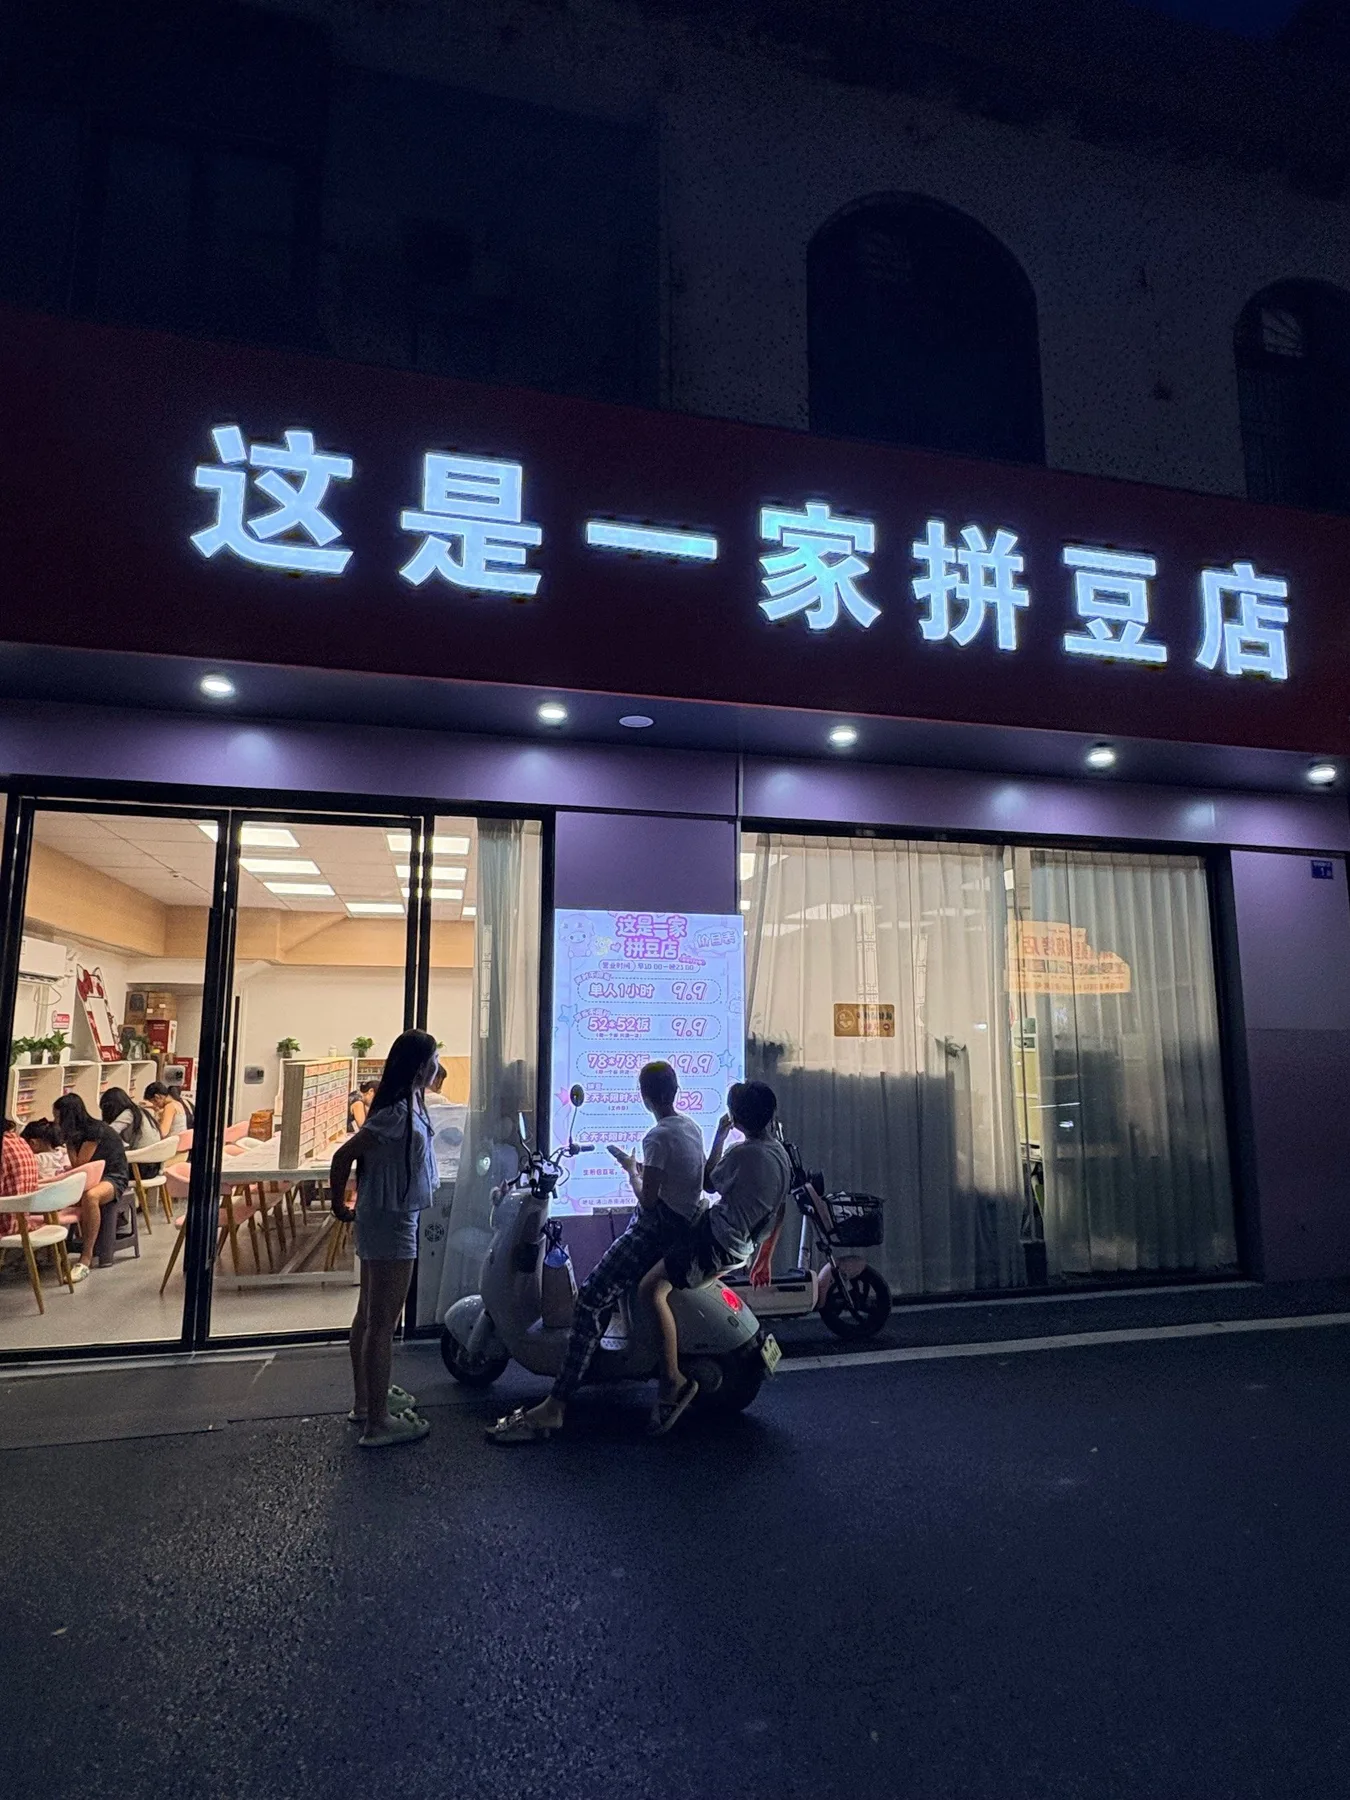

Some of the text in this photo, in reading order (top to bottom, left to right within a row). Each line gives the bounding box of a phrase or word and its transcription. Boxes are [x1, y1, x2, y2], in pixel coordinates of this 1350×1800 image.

[190, 424, 1291, 681] 这是一家拼豆店
[615, 914, 688, 939] 这是一家
[624, 937, 680, 960] 拼豆店
[697, 931, 735, 948] 价目表
[589, 981, 707, 1000] 单人1小时 9.9
[671, 1017, 707, 1036] 9.9
[668, 1053, 713, 1074] 19.9
[675, 1091, 704, 1111] 52
